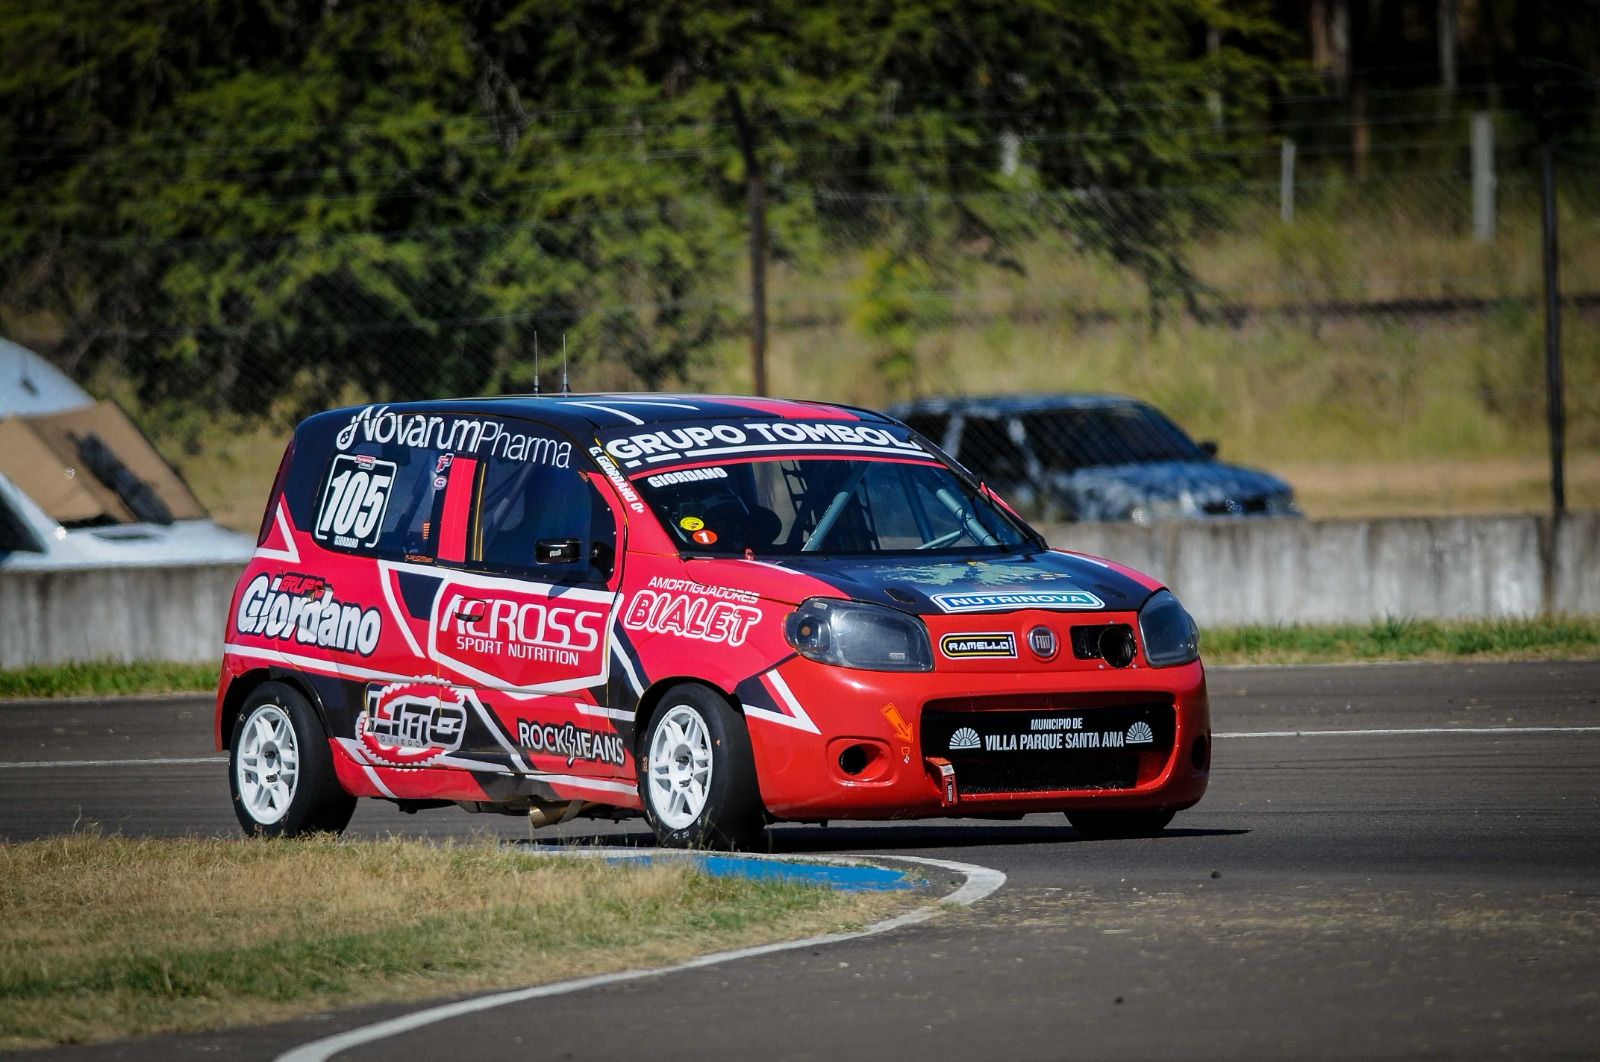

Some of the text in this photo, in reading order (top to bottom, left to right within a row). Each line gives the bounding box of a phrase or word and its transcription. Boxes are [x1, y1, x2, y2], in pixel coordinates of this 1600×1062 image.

[606, 424, 747, 459] GRUPO
[647, 467, 728, 488] GIORDANO
[320, 469, 392, 539] 105
[699, 531, 710, 543] 1
[648, 576, 760, 604] AMORTIGUADORES
[951, 591, 1086, 606] NUTRINOVA
[237, 574, 382, 655] Giordano
[440, 593, 603, 653] ACROSS
[624, 589, 763, 647] BIALET
[456, 637, 579, 667] SPORT NUTRITION
[949, 642, 1009, 651] RAMELLO
[1035, 635, 1050, 649] FIAT
[1031, 717, 1083, 730] MUNICIPIO DE
[518, 721, 569, 754] ROCK
[575, 731, 625, 765] JEANS
[985, 731, 1124, 751] VILLA PARQUE SANTA ANA
